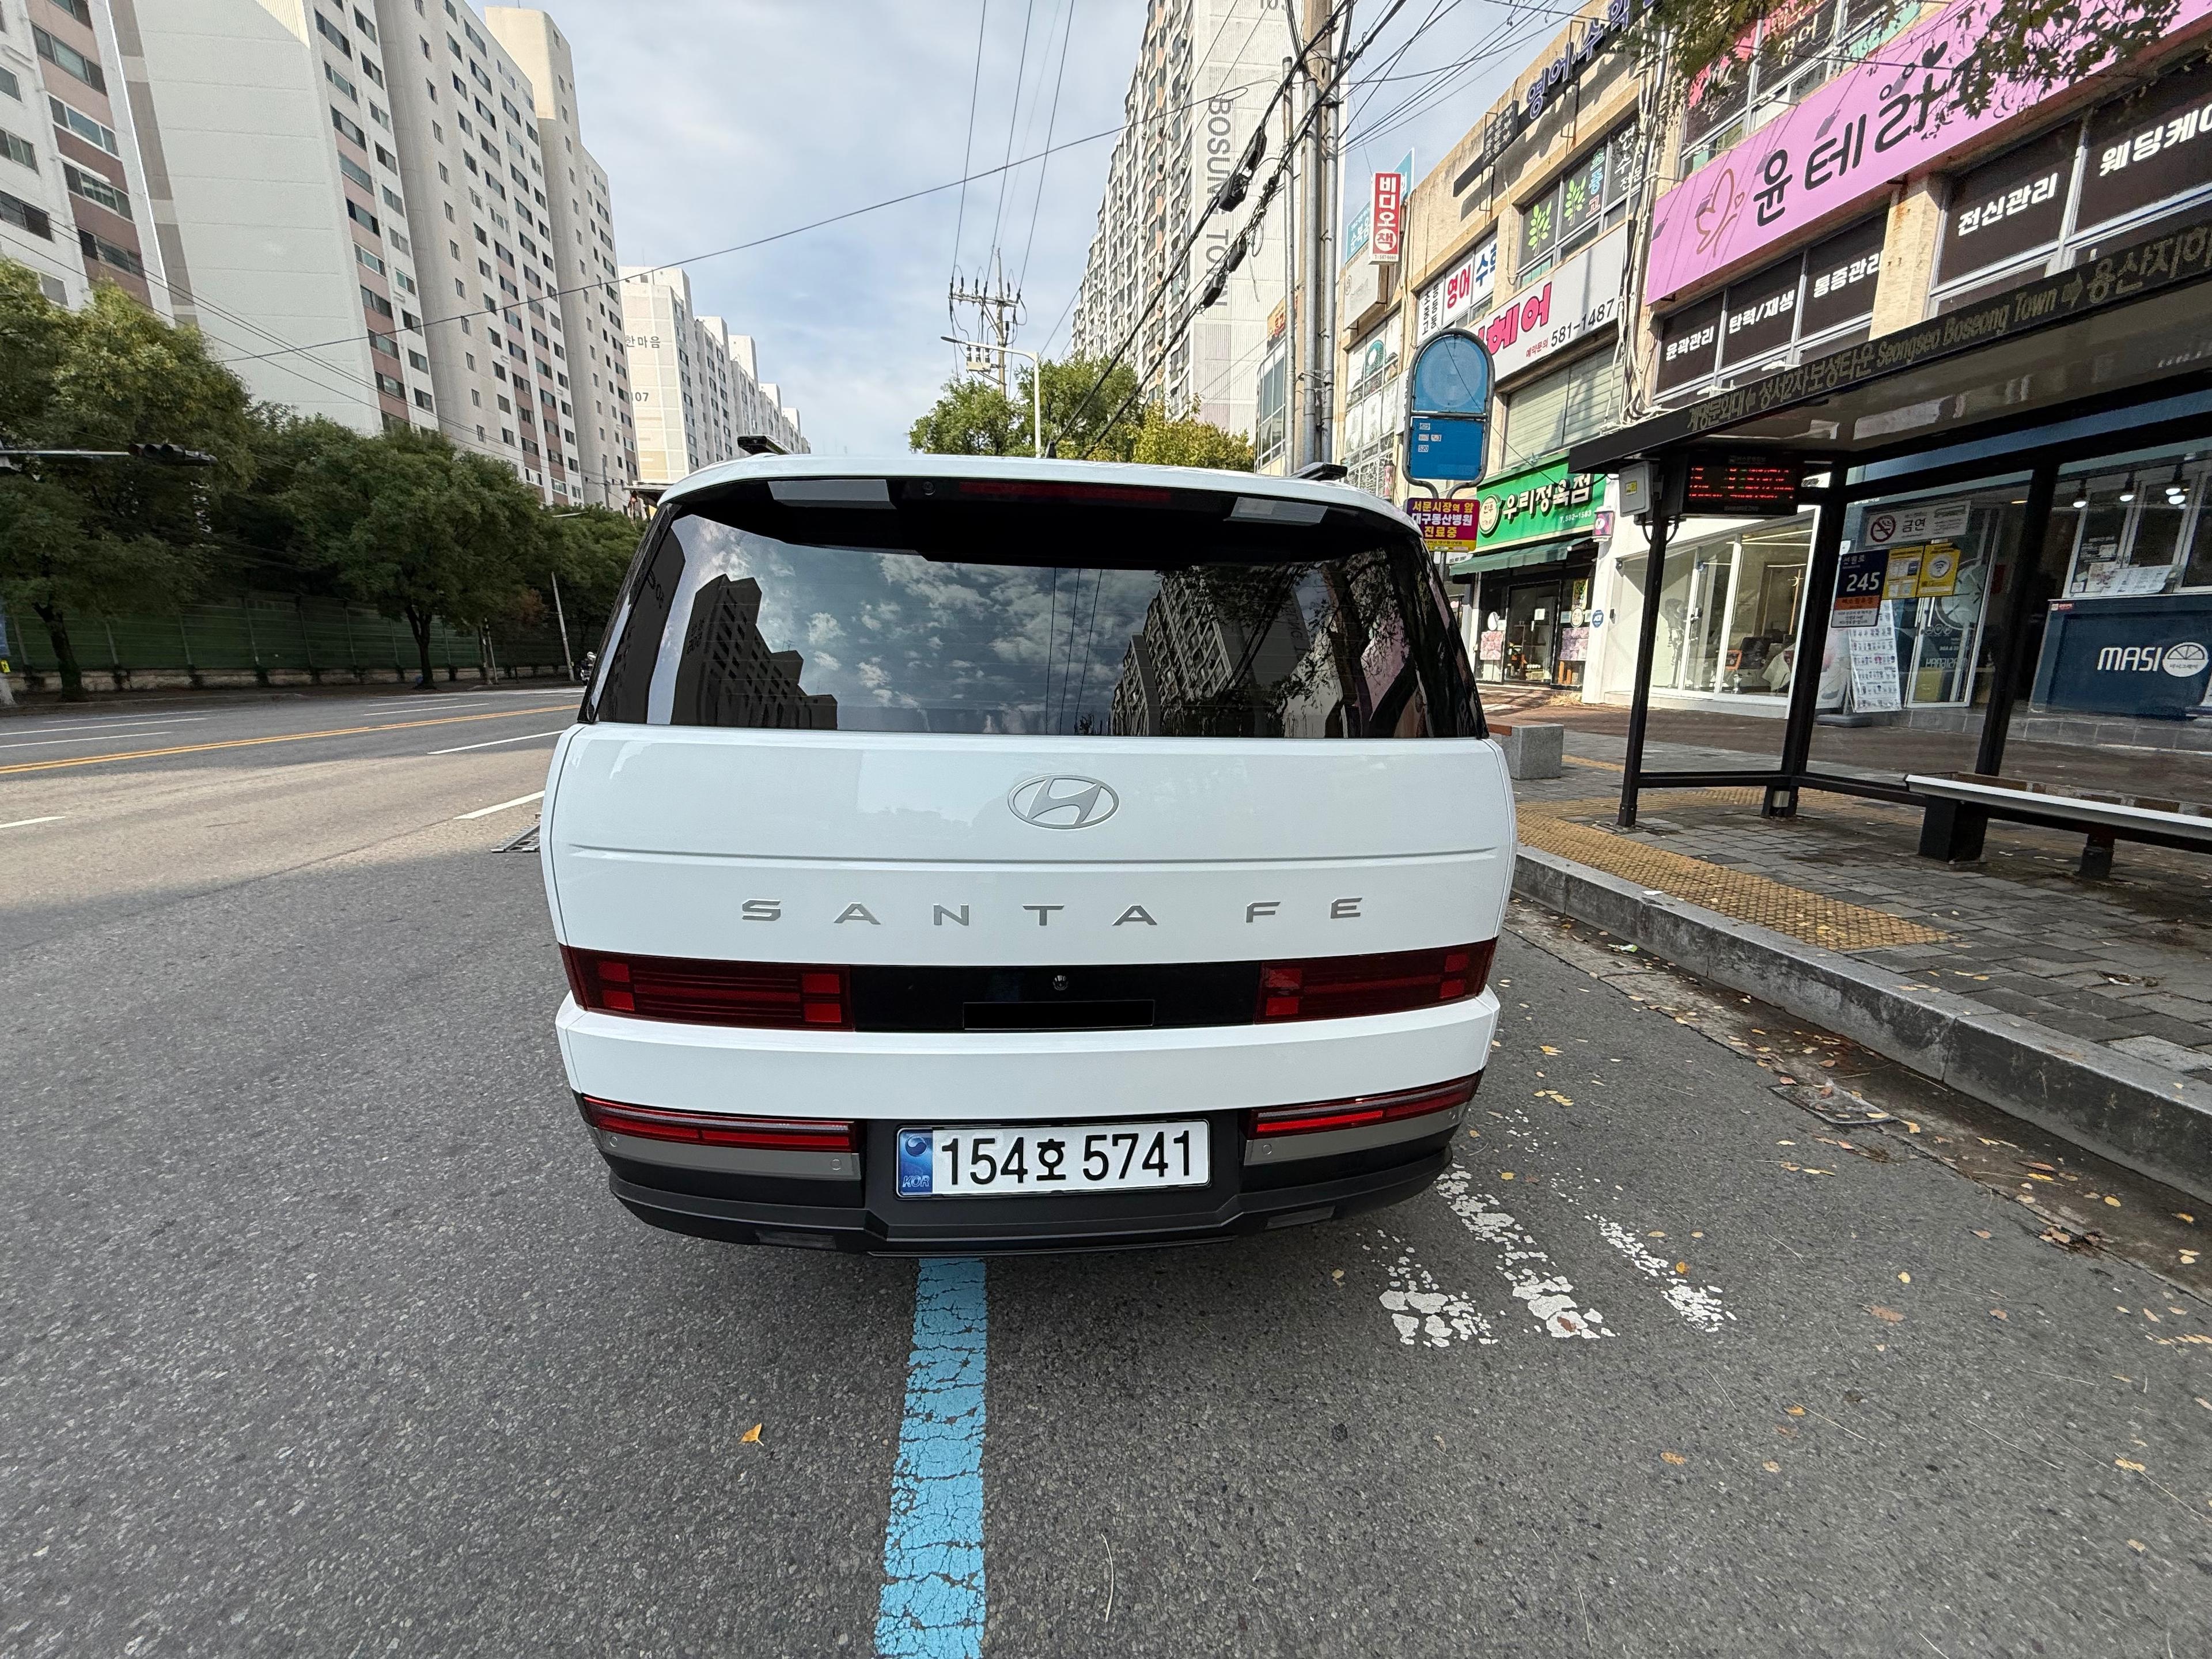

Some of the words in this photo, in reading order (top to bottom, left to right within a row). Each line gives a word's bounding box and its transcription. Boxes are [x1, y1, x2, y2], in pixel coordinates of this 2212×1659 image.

[1206, 96, 1232, 215] BOSUN
[1959, 173, 2058, 236] 전신관리
[1448, 264, 1471, 309] 영어
[1813, 250, 1883, 298] 통증관리
[1478, 281, 1552, 355] 헤어
[1551, 297, 1615, 347] 581-1487
[1729, 290, 1795, 334] 탄력/재생
[2014, 287, 2058, 322] Town
[624, 335, 661, 349] 한마음
[1666, 325, 1714, 361] 윤곽관리
[632, 392, 649, 403] 07
[1412, 501, 1460, 513] 서문시장역
[1464, 502, 1474, 513] 앞
[1502, 472, 1592, 520] 우리정육점
[1412, 513, 1473, 526] 대구동산병원
[1424, 525, 1457, 538] 진료중
[1903, 518, 1926, 533] 금연
[1846, 571, 1881, 592] 245
[2097, 647, 2163, 672] MASI
[741, 899, 1158, 927] SANTA
[1245, 897, 1363, 923] FE
[941, 1136, 1066, 1185] 154호
[1082, 1130, 1192, 1181] 5741
[902, 1175, 930, 1188] KOR
